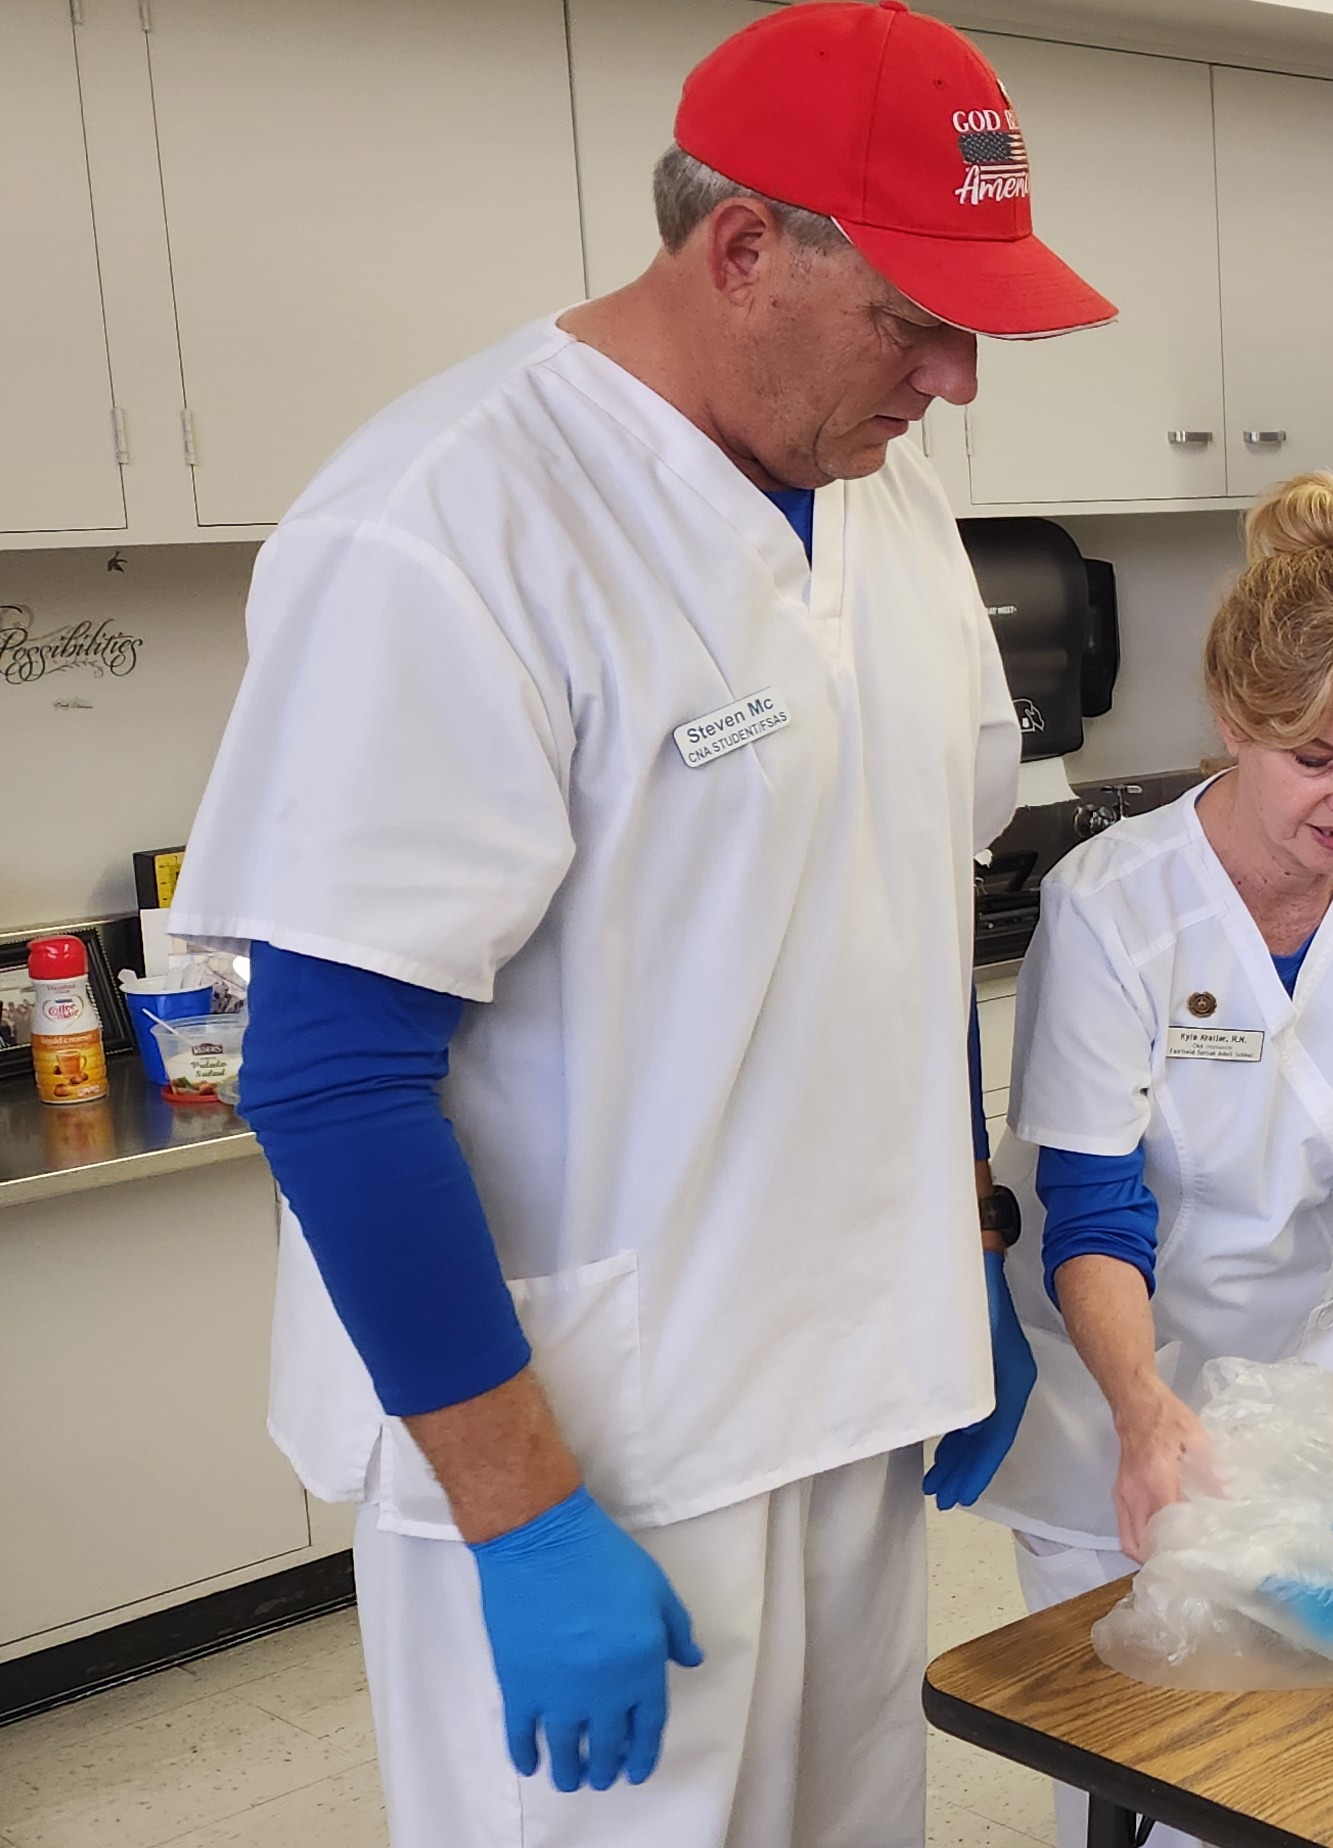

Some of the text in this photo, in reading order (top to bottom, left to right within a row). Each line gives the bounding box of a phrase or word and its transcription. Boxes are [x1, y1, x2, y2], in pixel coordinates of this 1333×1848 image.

[952, 110, 1001, 133] GOD
[954, 164, 1029, 205] Ameri
[0, 618, 143, 685] Possibilities
[686, 697, 774, 744] Steven Mc
[688, 711, 788, 763] CNA STUDENT/FSAS
[48, 1003, 76, 1017] Coffee
[1180, 1033, 1198, 1042] Kyle
